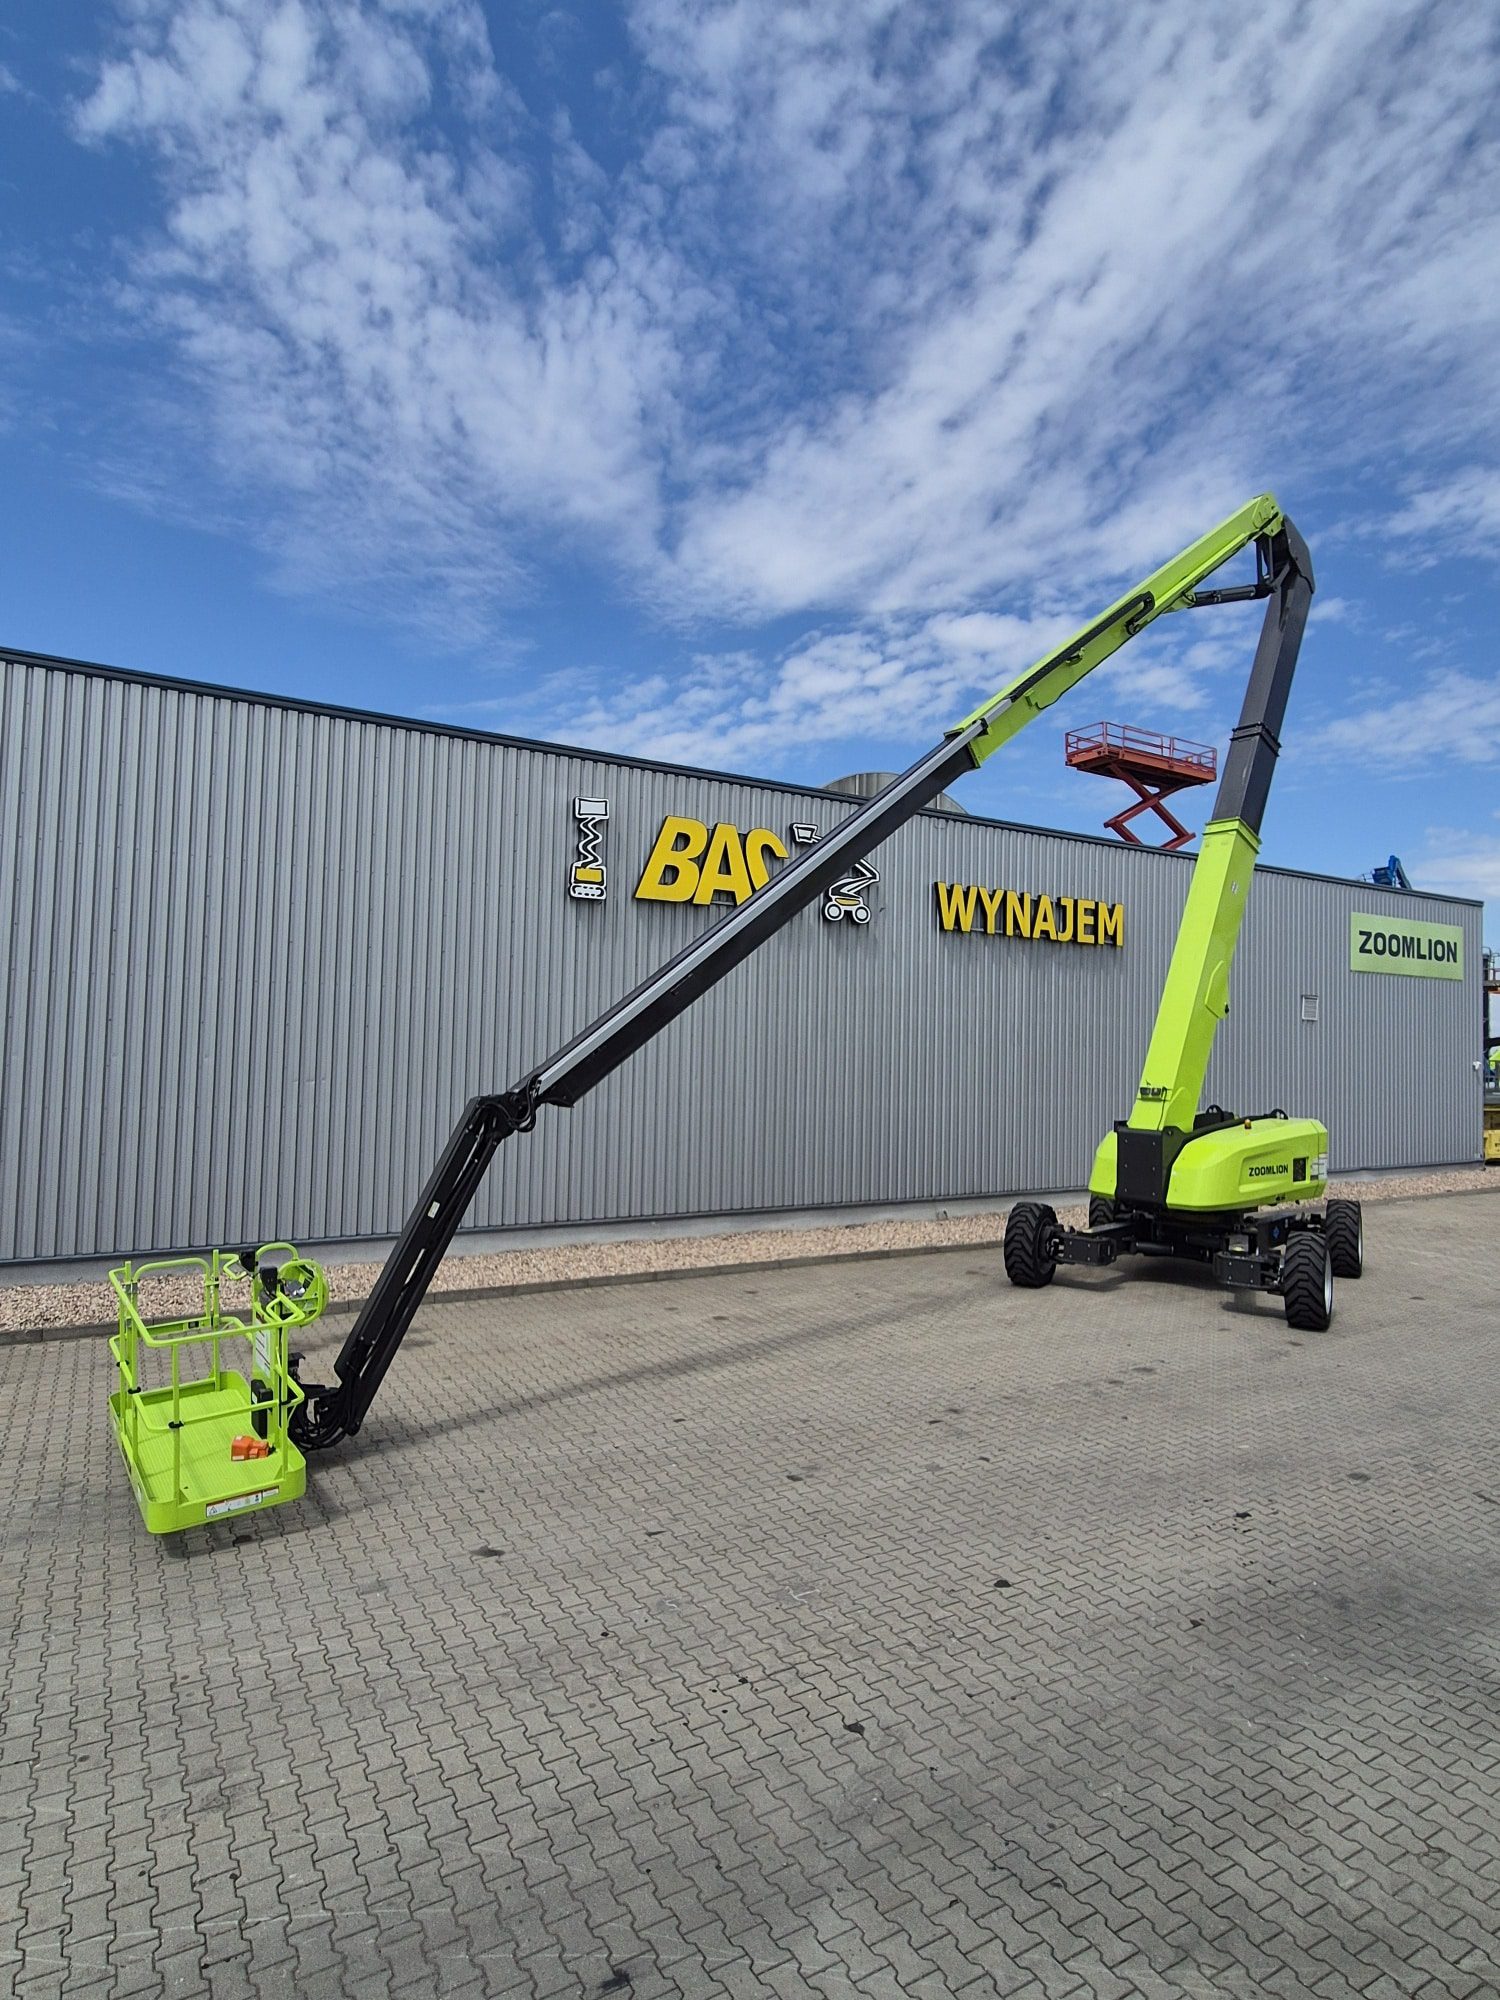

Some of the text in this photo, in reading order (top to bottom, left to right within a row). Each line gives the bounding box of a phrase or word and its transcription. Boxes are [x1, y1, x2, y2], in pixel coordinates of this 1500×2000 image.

[935, 882, 1125, 947] WYNAJEM
[1358, 931, 1458, 963] ZOOMLION
[1248, 1164, 1289, 1177] ZOOMLION
